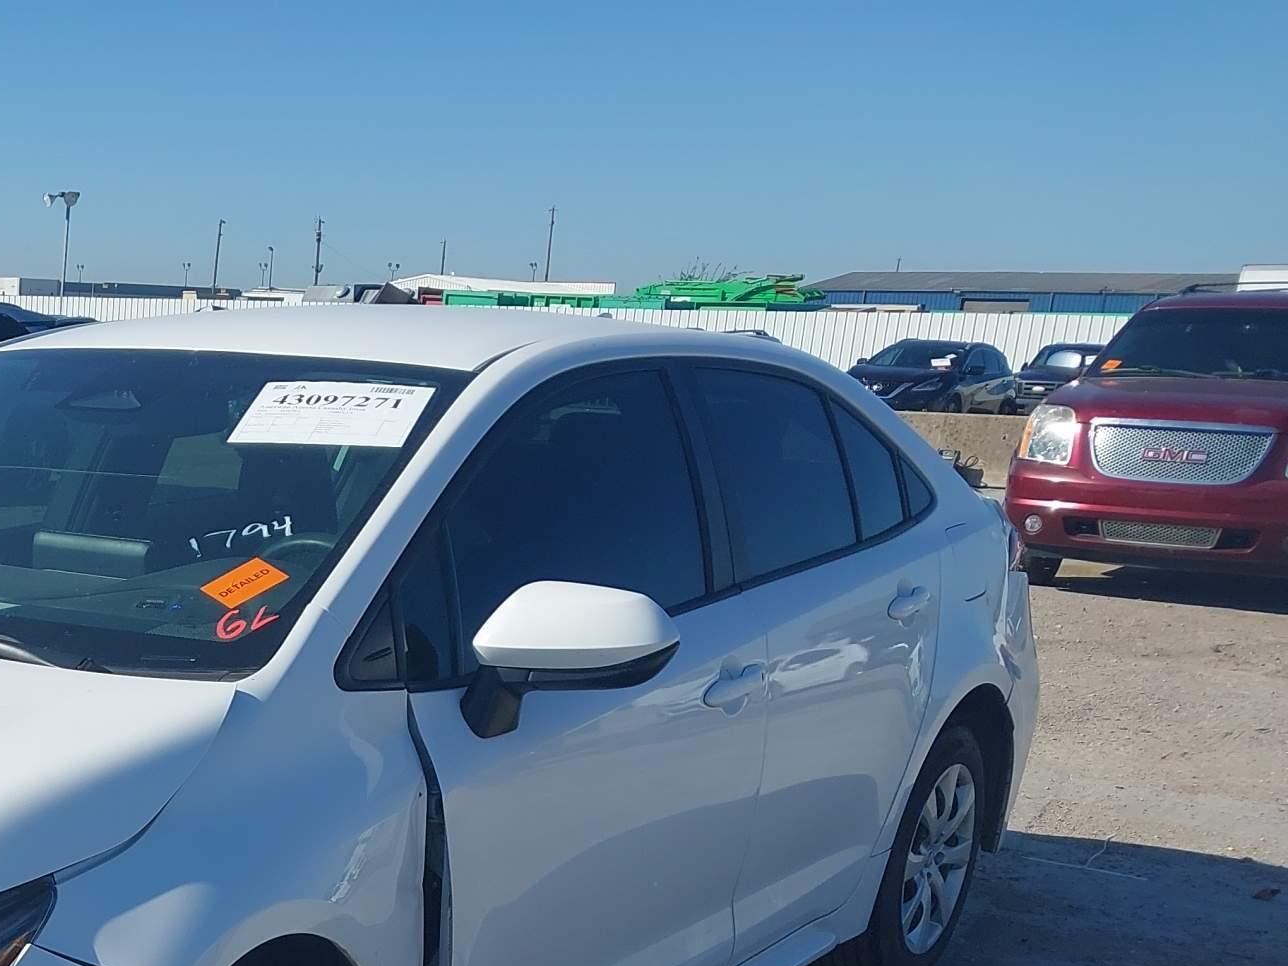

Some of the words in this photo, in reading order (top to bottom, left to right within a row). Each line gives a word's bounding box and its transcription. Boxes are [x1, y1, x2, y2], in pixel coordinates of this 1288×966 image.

[272, 393, 403, 409] 43097271
[1143, 447, 1208, 464] GMC
[219, 568, 270, 598] DETAILED
